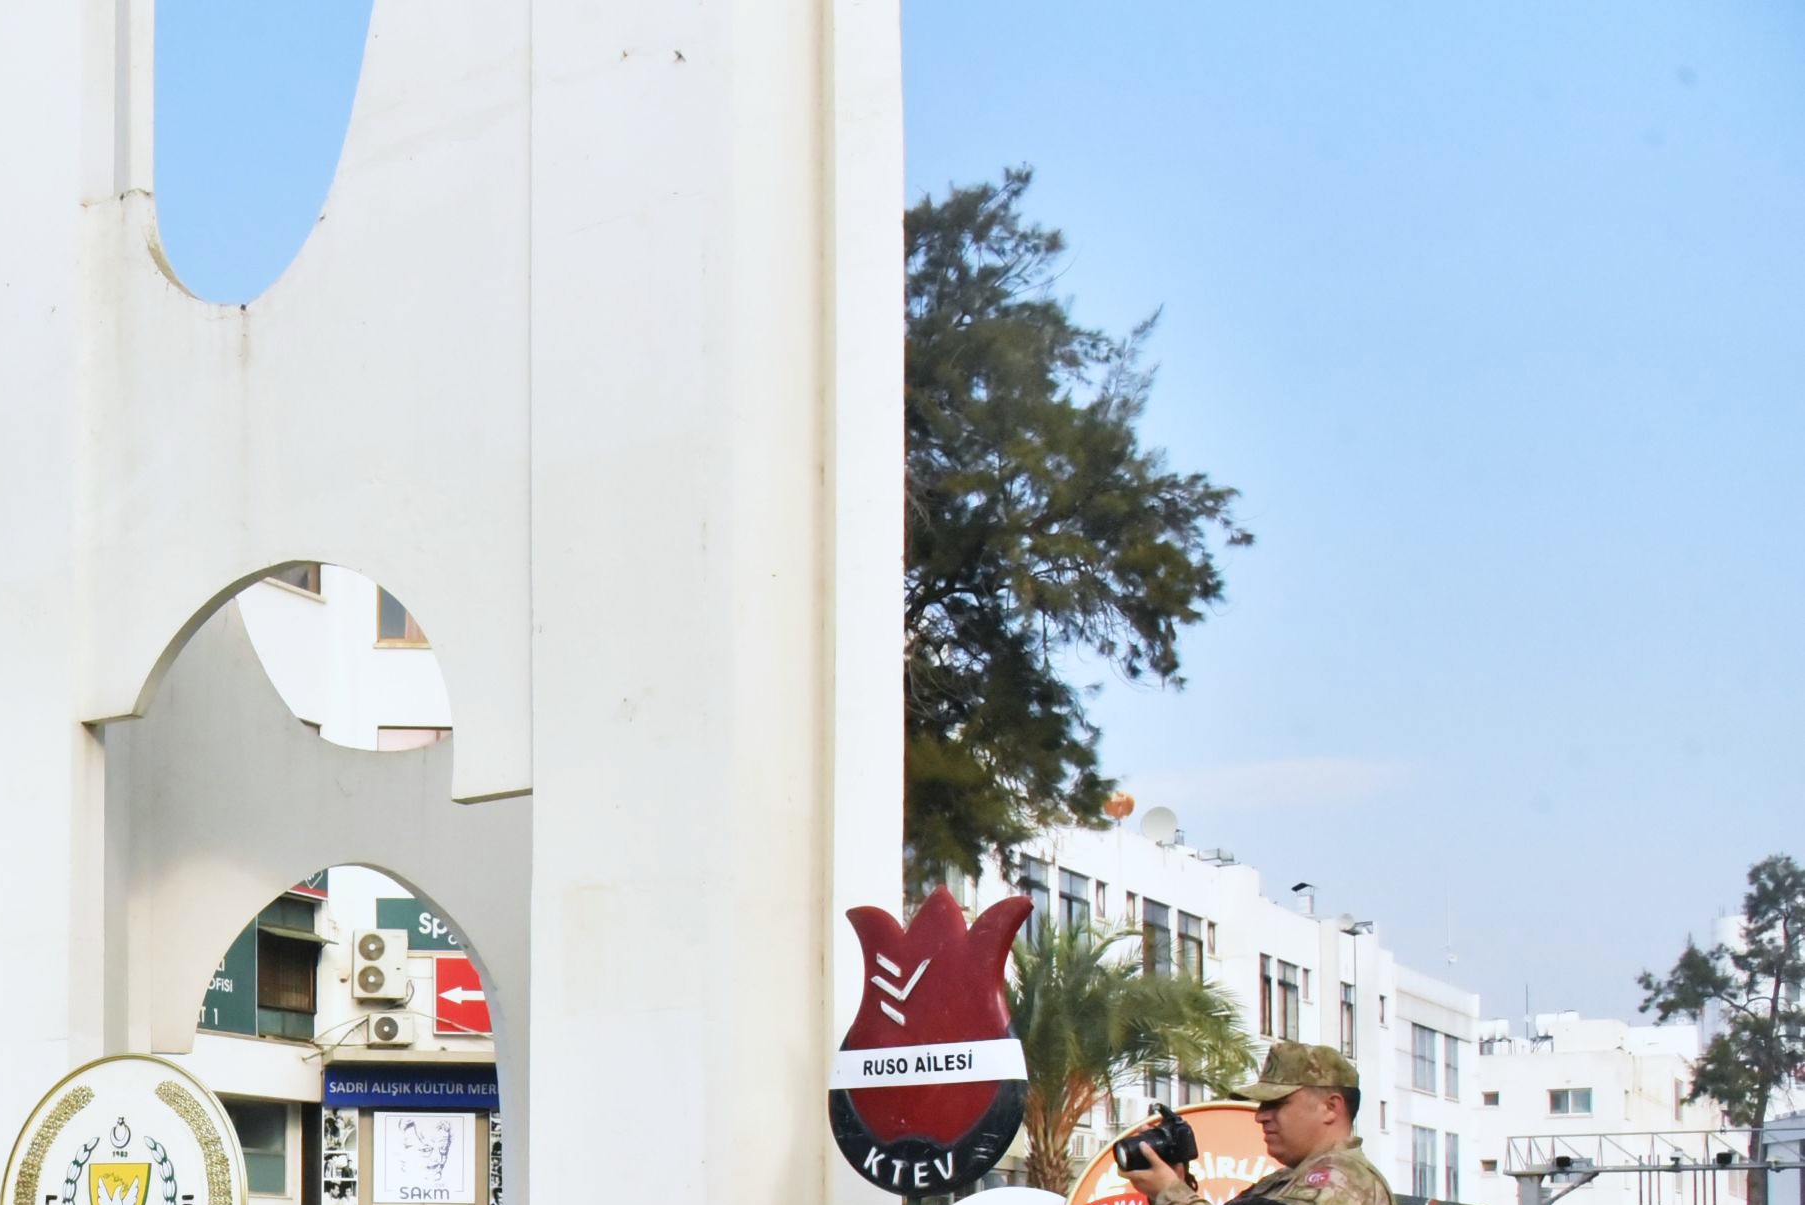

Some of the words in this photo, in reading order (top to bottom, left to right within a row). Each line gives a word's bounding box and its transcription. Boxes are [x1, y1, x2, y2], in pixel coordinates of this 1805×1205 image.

[863, 1056, 908, 1077] RUSO
[915, 1048, 974, 1074] AİLESİ
[329, 1080, 368, 1094] SADRİ
[371, 1081, 411, 1097] ALIŞIK
[414, 1080, 464, 1095] KÜLTÜR
[467, 1083, 499, 1096] MER
[864, 1146, 955, 1189] KTEV
